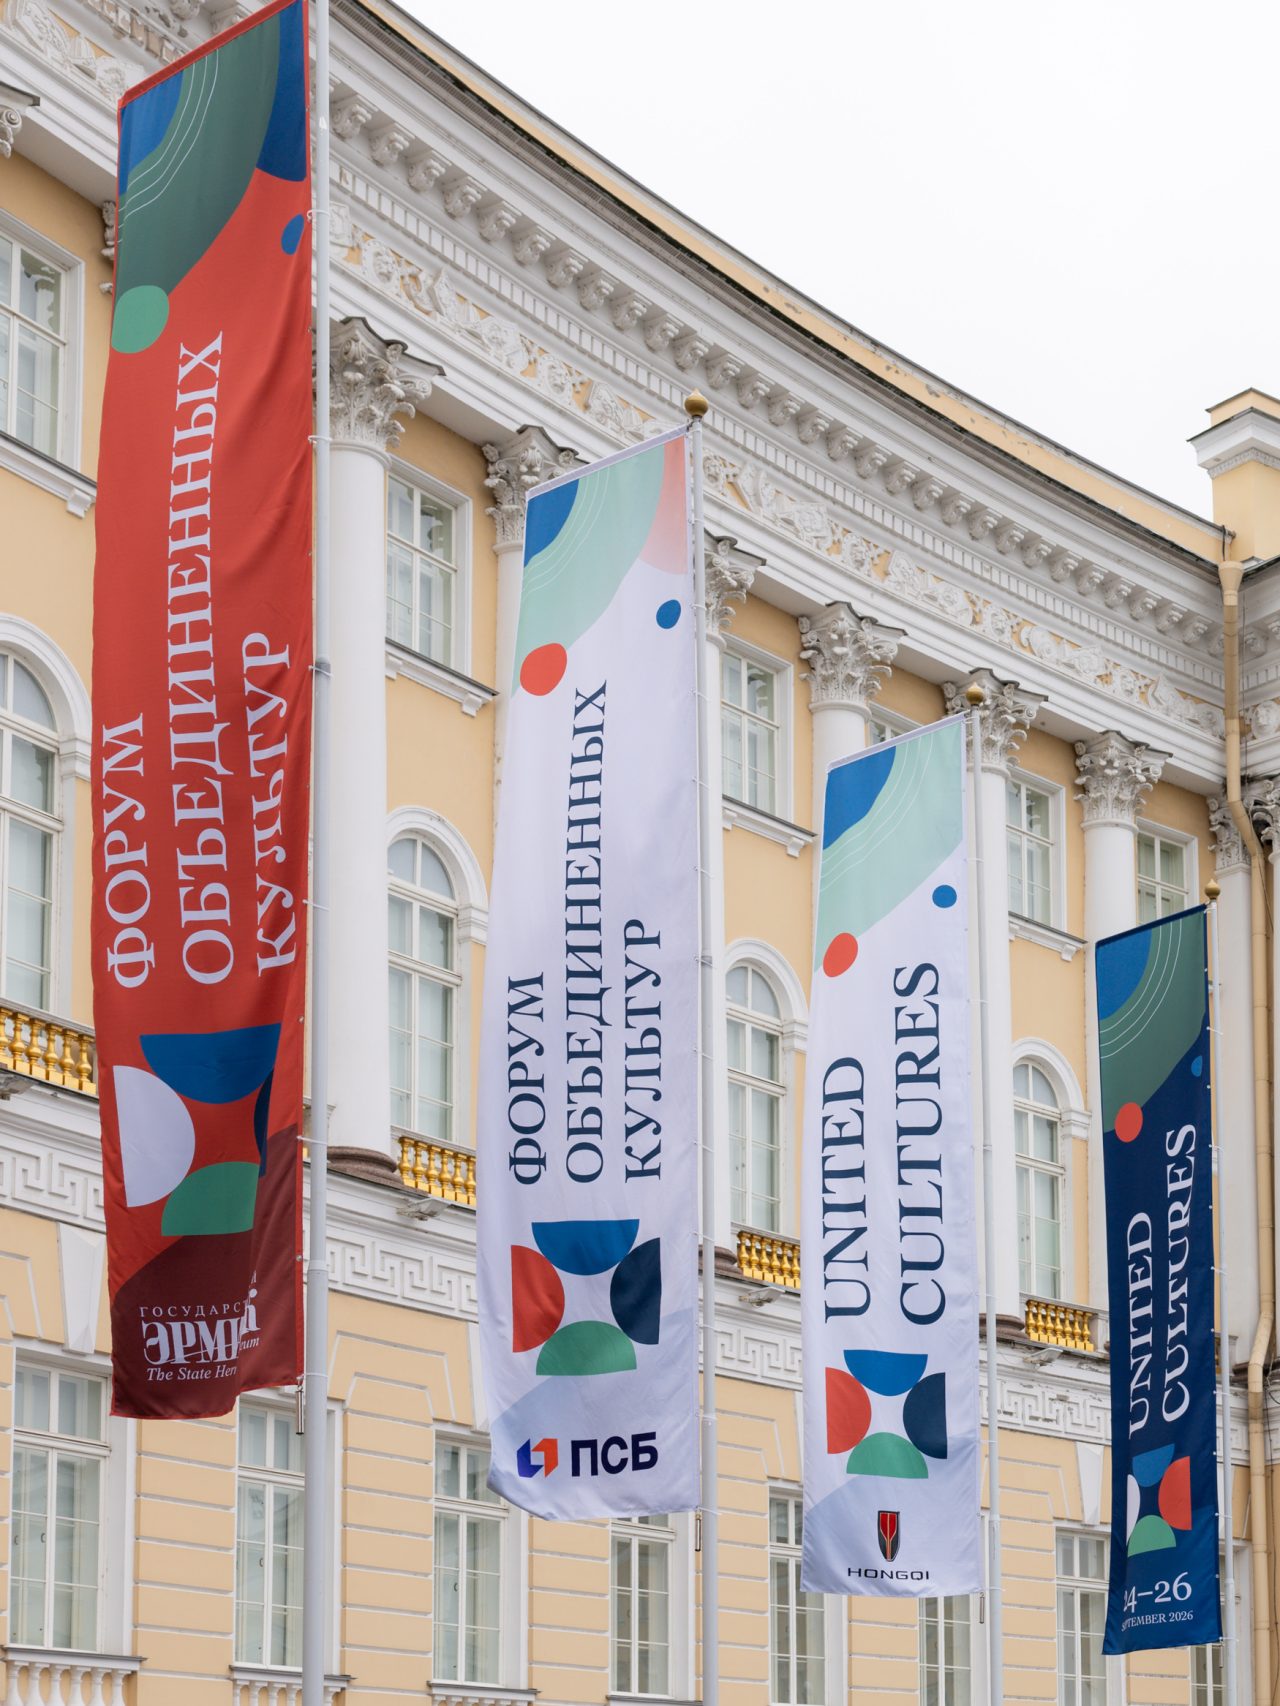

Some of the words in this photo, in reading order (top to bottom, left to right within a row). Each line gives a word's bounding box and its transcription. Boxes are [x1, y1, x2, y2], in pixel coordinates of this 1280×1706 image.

[167, 331, 235, 984] ОБЪЕДИНЕННЫХ
[102, 713, 155, 988] ФОРУМ
[241, 632, 297, 977] КУЛЬТУР
[565, 680, 613, 1184] ОБЪЕДИНЕННЫХ
[507, 971, 547, 1185] ФОРУМ
[623, 918, 662, 1183] КУЛЬТУР
[893, 962, 946, 1325] CULTURES
[822, 1057, 871, 1323] UNITED
[1162, 1124, 1196, 1422] CULTURES
[147, 1367, 173, 1381] The
[177, 1366, 211, 1381] State
[571, 1431, 658, 1477] ПСБ
[1127, 1212, 1153, 1440] UNITED
[847, 1567, 930, 1581] HONGQI
[1168, 1610, 1194, 1622] 2026
